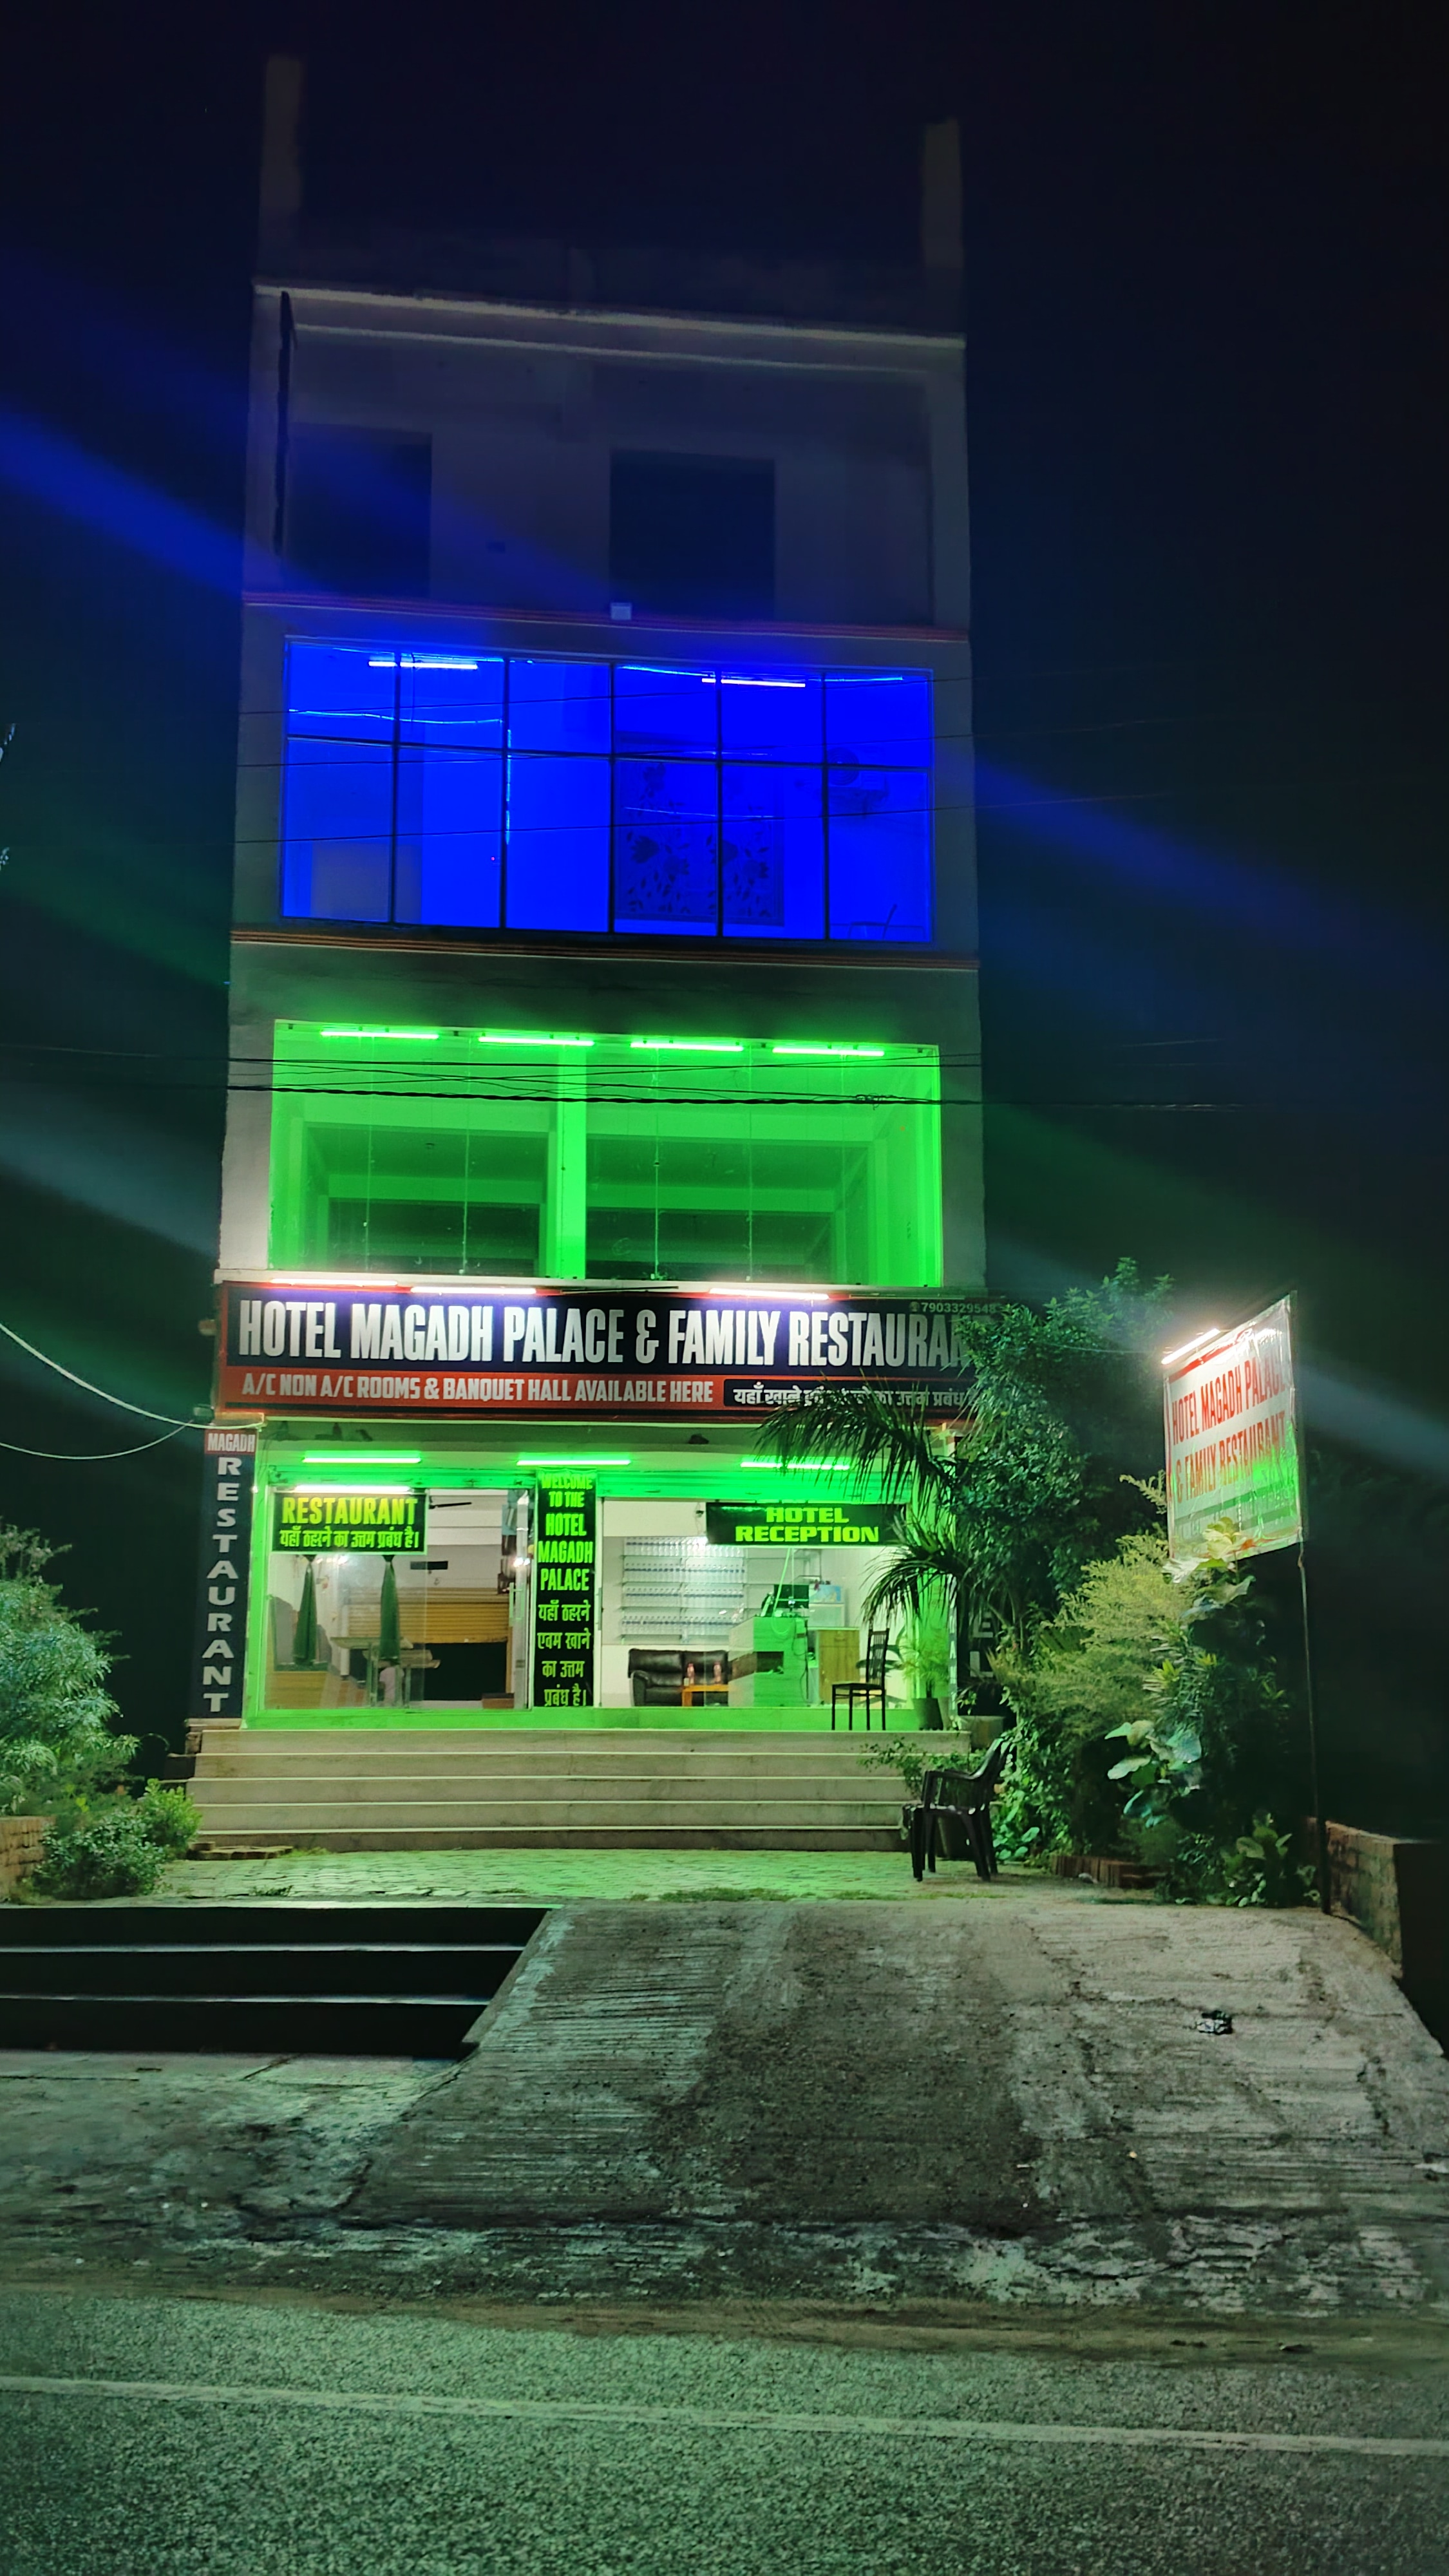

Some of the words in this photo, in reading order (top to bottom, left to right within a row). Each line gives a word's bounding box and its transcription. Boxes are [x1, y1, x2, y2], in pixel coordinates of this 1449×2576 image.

[921, 1302, 996, 1313] 7903329548
[239, 1300, 341, 1358] HOTEL
[351, 1303, 493, 1361] MAGADH
[503, 1307, 624, 1363] PALACE
[636, 1309, 659, 1364] &
[668, 1310, 781, 1366] FAMILY
[242, 1373, 276, 1396] A/C
[279, 1374, 317, 1396] NON
[320, 1375, 354, 1397] A/C
[357, 1376, 421, 1399] ROOMS
[424, 1378, 439, 1399] &
[443, 1378, 525, 1401] BANQUET
[527, 1379, 571, 1401] HALL
[574, 1379, 666, 1403] AVAILABLE
[670, 1381, 713, 1403] HERE
[733, 1381, 764, 1405] यहाँ
[764, 1385, 802, 1405] खाने
[1172, 1390, 1199, 1445] HOTEL
[1200, 1365, 1242, 1432] MAGADH
[207, 1433, 256, 1453] MAGADH
[541, 1473, 593, 1490] WELCOME
[1177, 1459, 1183, 1503] &
[1185, 1444, 1217, 1501] FAMILY
[282, 1497, 418, 1525] RESTAURANT
[549, 1492, 562, 1507] TO
[565, 1492, 585, 1508] THE
[545, 1513, 587, 1536] HOTEL
[766, 1507, 849, 1524] HOTEL
[279, 1526, 301, 1547] यहाँ
[333, 1530, 350, 1548] का
[350, 1531, 376, 1548] उत्तम
[735, 1526, 878, 1542] RECEPTION
[538, 1540, 593, 1563] MAGADH
[202, 1457, 242, 1713] RESTAURANT
[540, 1568, 589, 1591] PALACE
[538, 1600, 560, 1621] यहाँ
[562, 1600, 591, 1622] ठहरने
[537, 1633, 562, 1649] एवम
[565, 1627, 591, 1649] खाने
[542, 1661, 557, 1678] का
[560, 1661, 585, 1678] उत्तम
